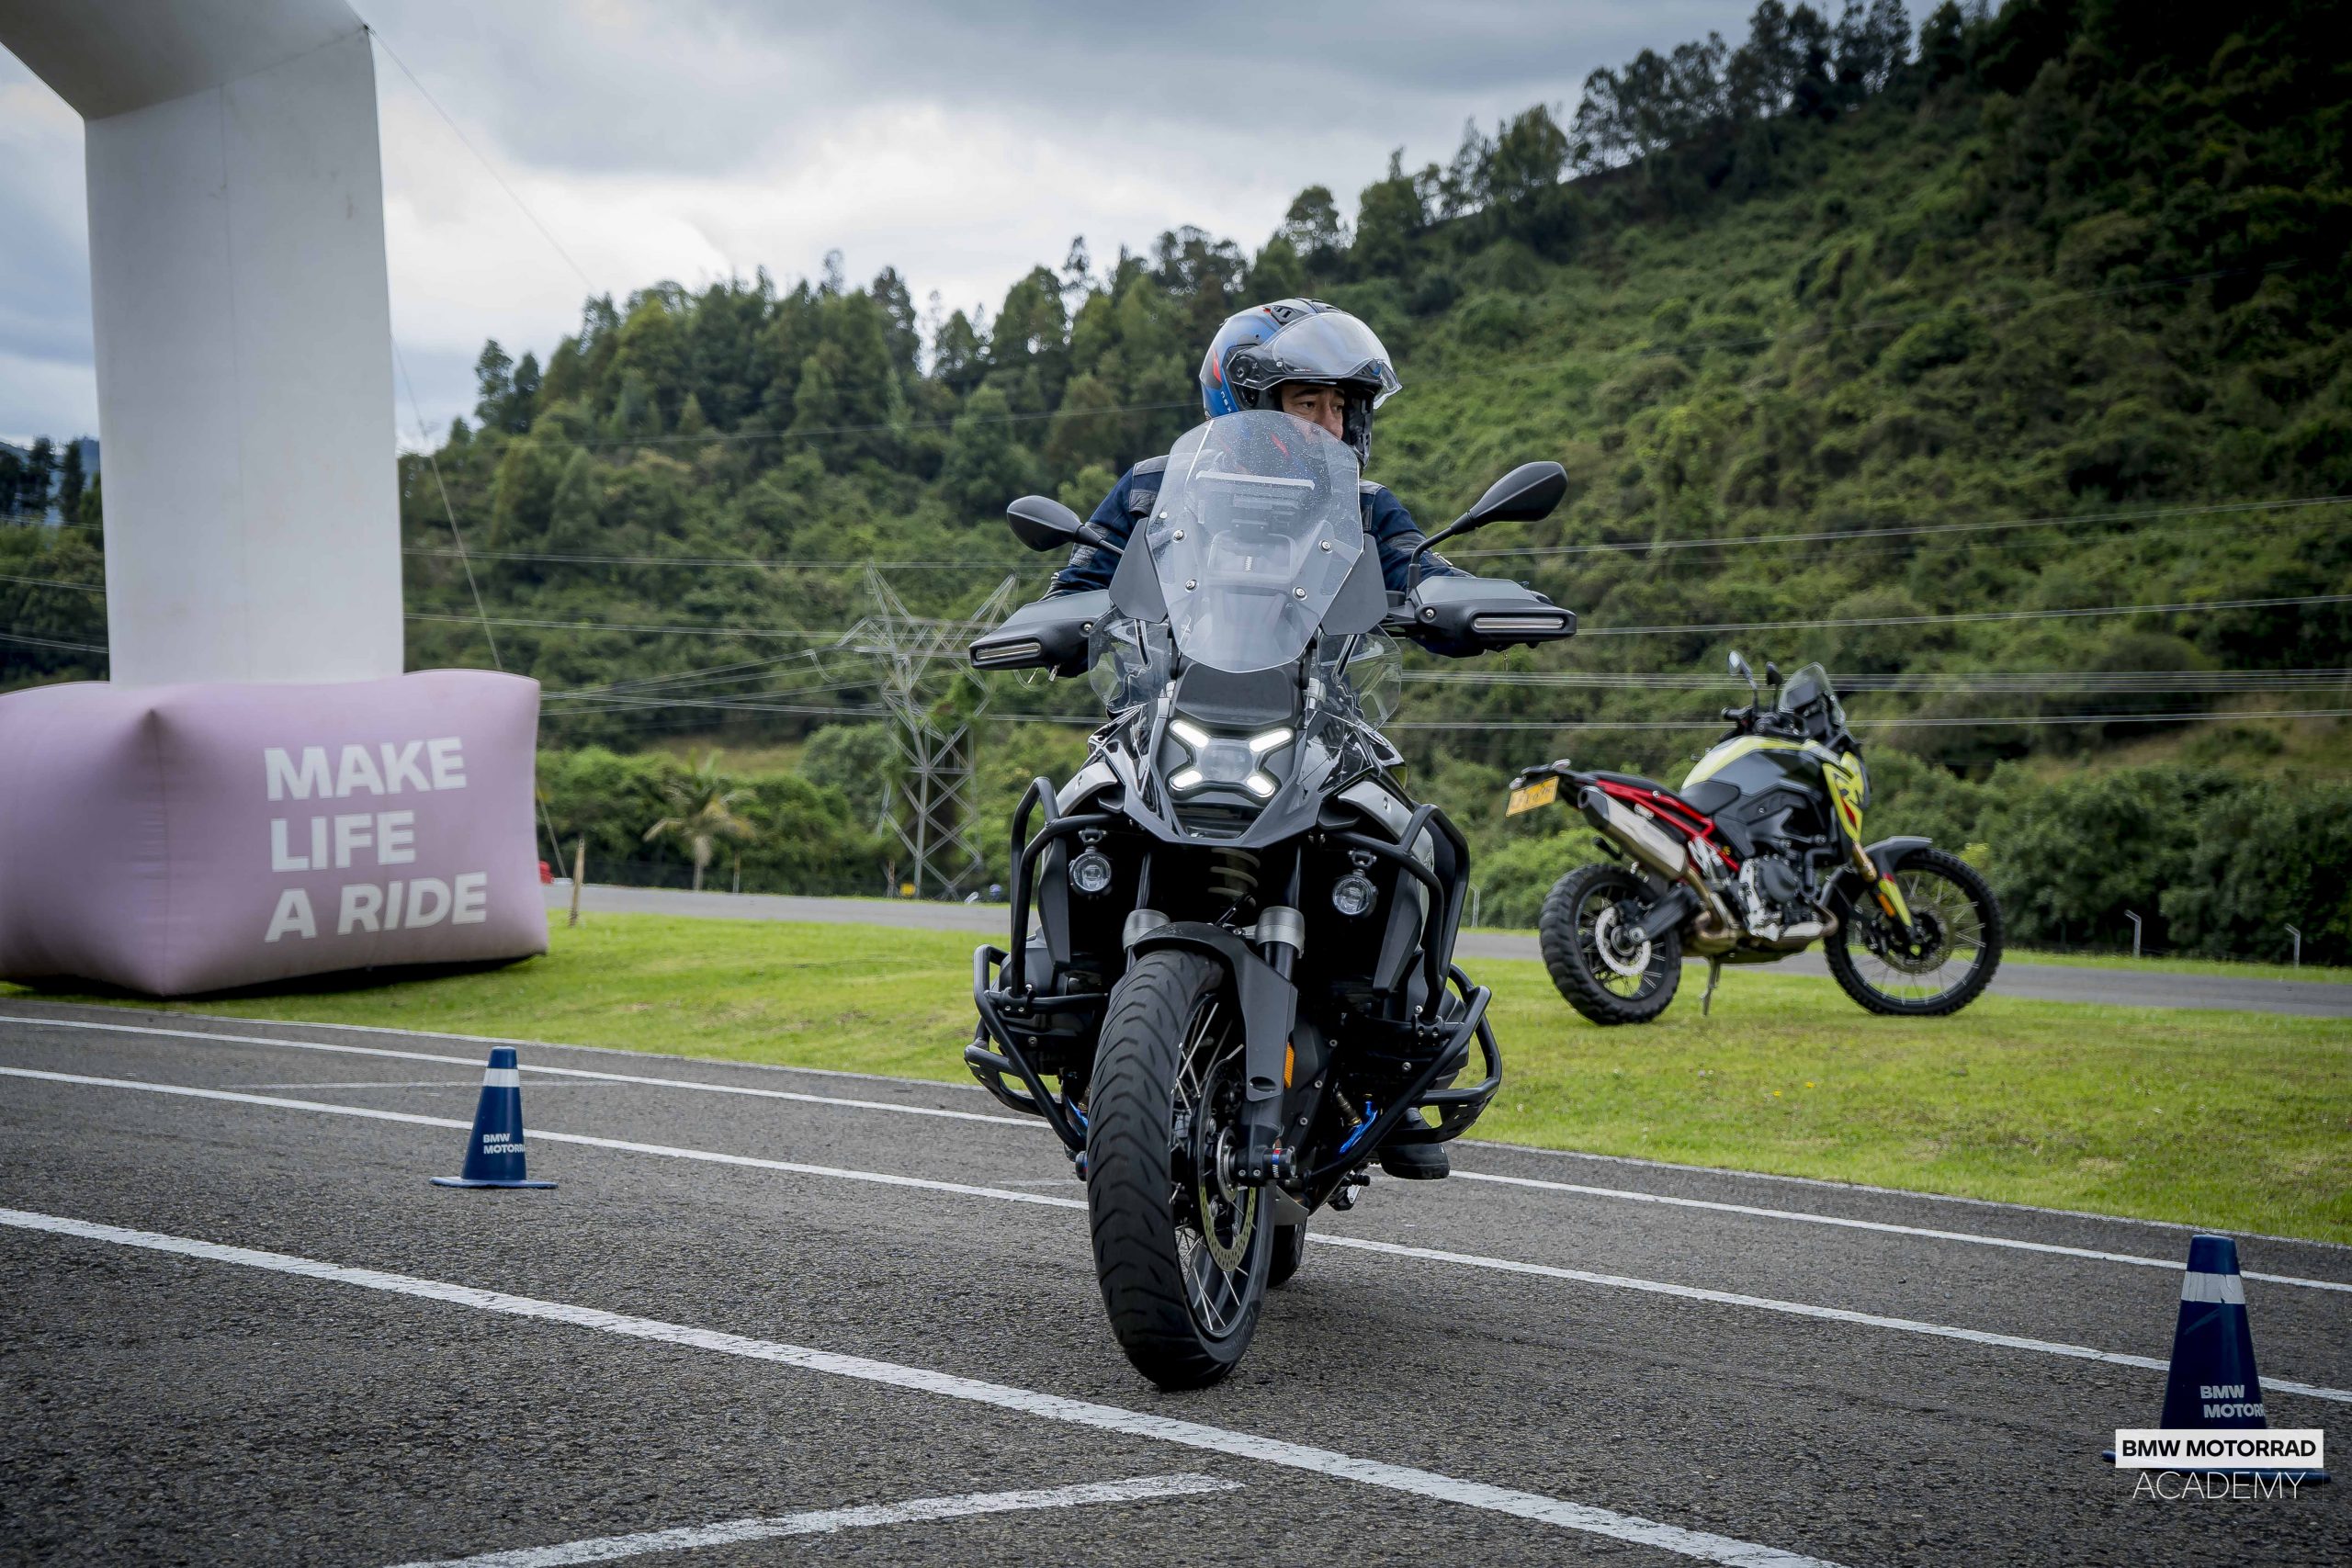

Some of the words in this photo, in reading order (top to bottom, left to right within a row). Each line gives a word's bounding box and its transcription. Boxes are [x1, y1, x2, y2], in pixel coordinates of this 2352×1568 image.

[264, 736, 467, 802] MAKE
[270, 809, 415, 873] LIFE
[264, 887, 318, 943] A
[336, 871, 487, 936] RIDE
[483, 1134, 510, 1143] BMW
[2199, 1384, 2245, 1399] BMW
